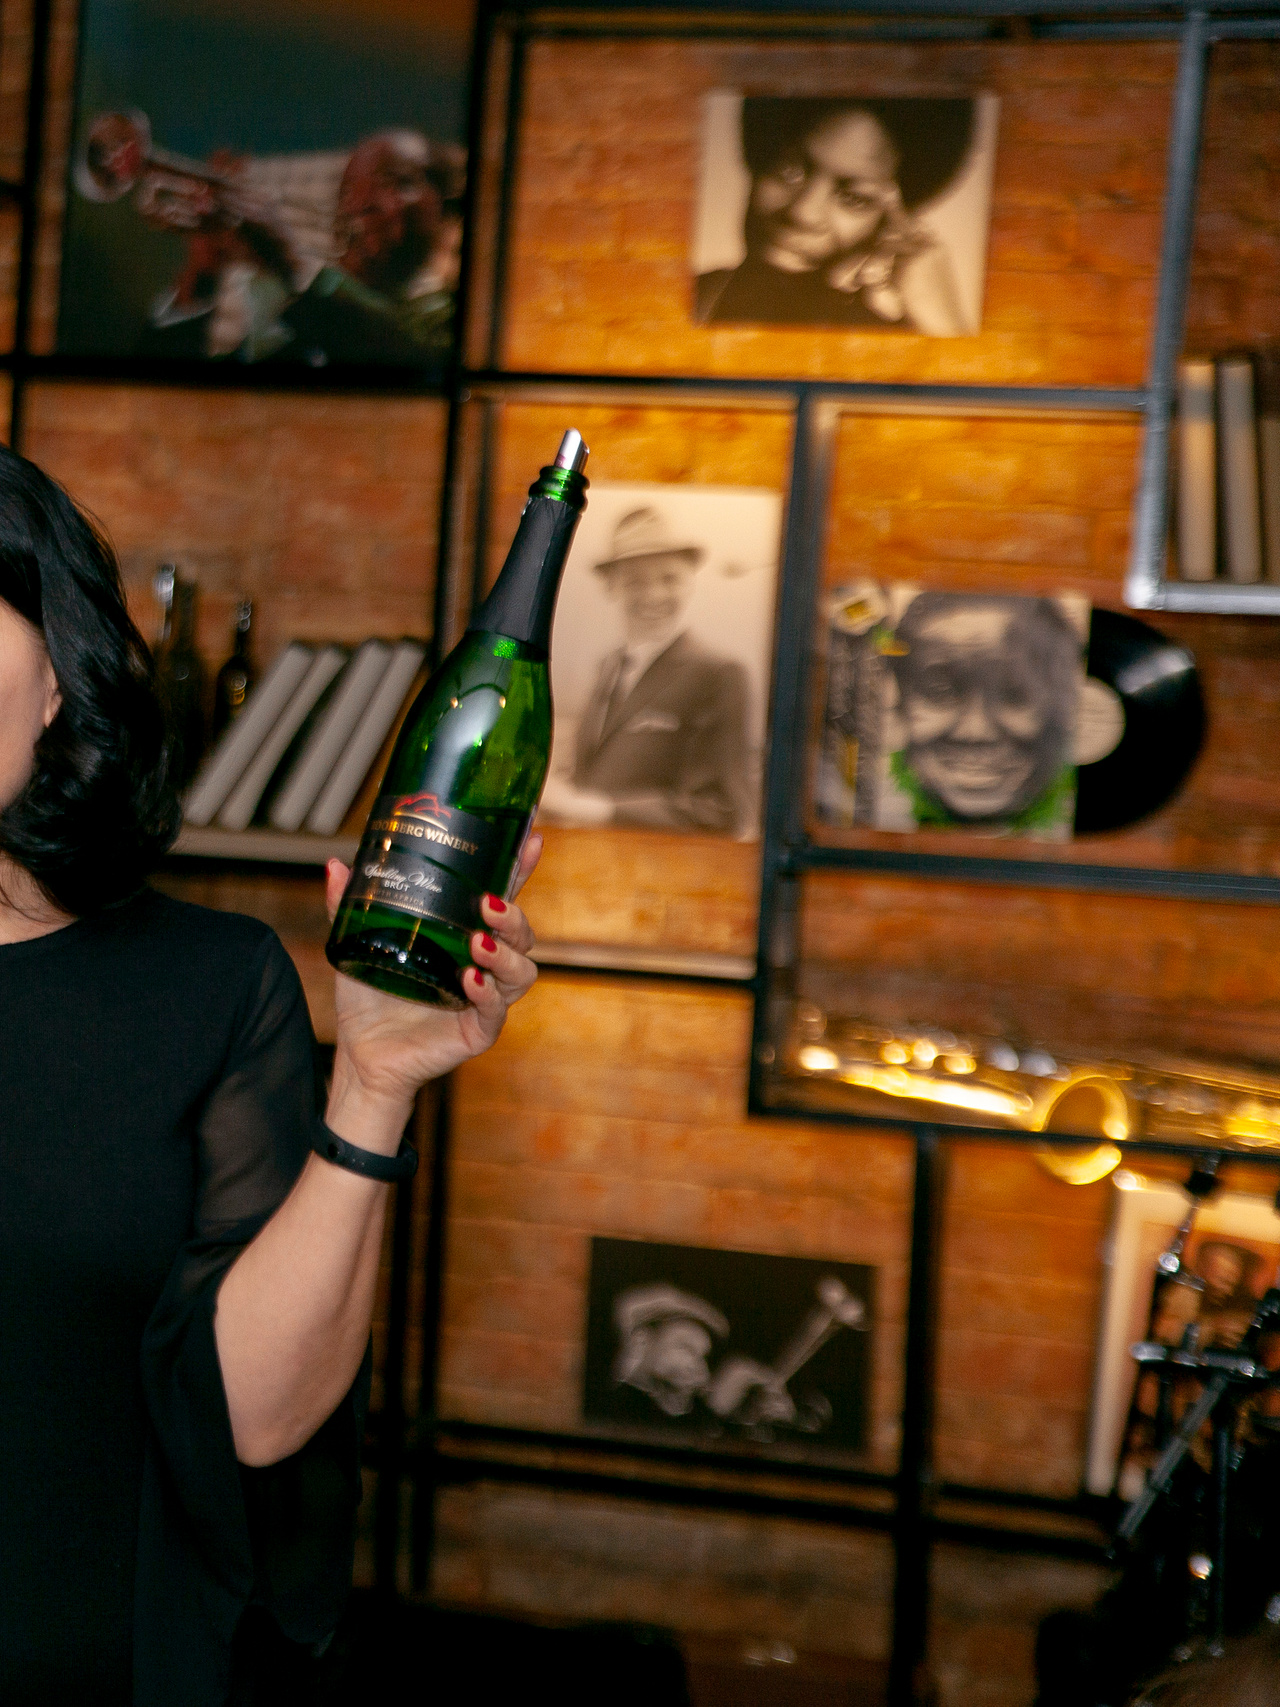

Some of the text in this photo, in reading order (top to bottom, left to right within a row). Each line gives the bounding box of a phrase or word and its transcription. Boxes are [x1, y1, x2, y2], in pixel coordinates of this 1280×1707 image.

[425, 827, 479, 855] WINERY
[364, 864, 442, 893] Sparkling Wine
[384, 880, 410, 892] BRUT
